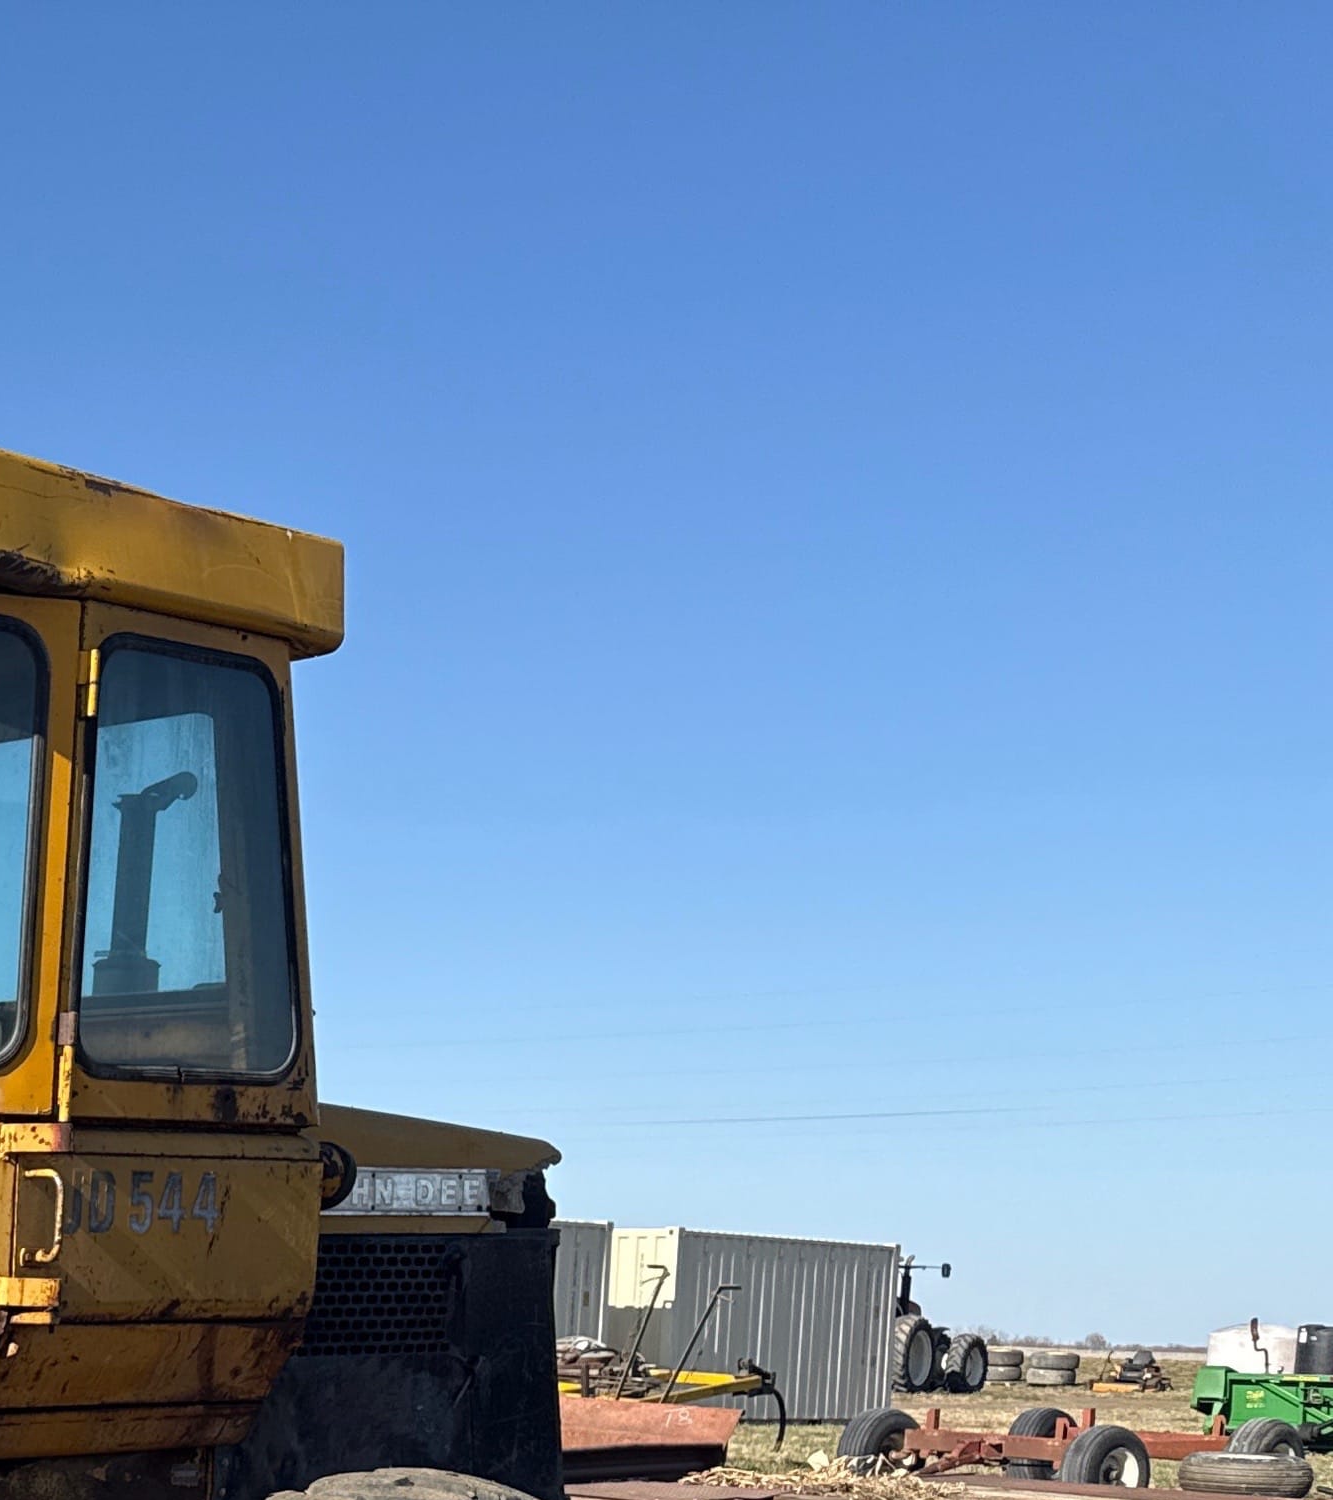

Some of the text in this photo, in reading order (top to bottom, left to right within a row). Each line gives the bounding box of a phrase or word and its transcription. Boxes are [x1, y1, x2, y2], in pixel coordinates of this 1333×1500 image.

[63, 1169, 221, 1236] JD 544
[350, 1177, 481, 1206] HN DEE
